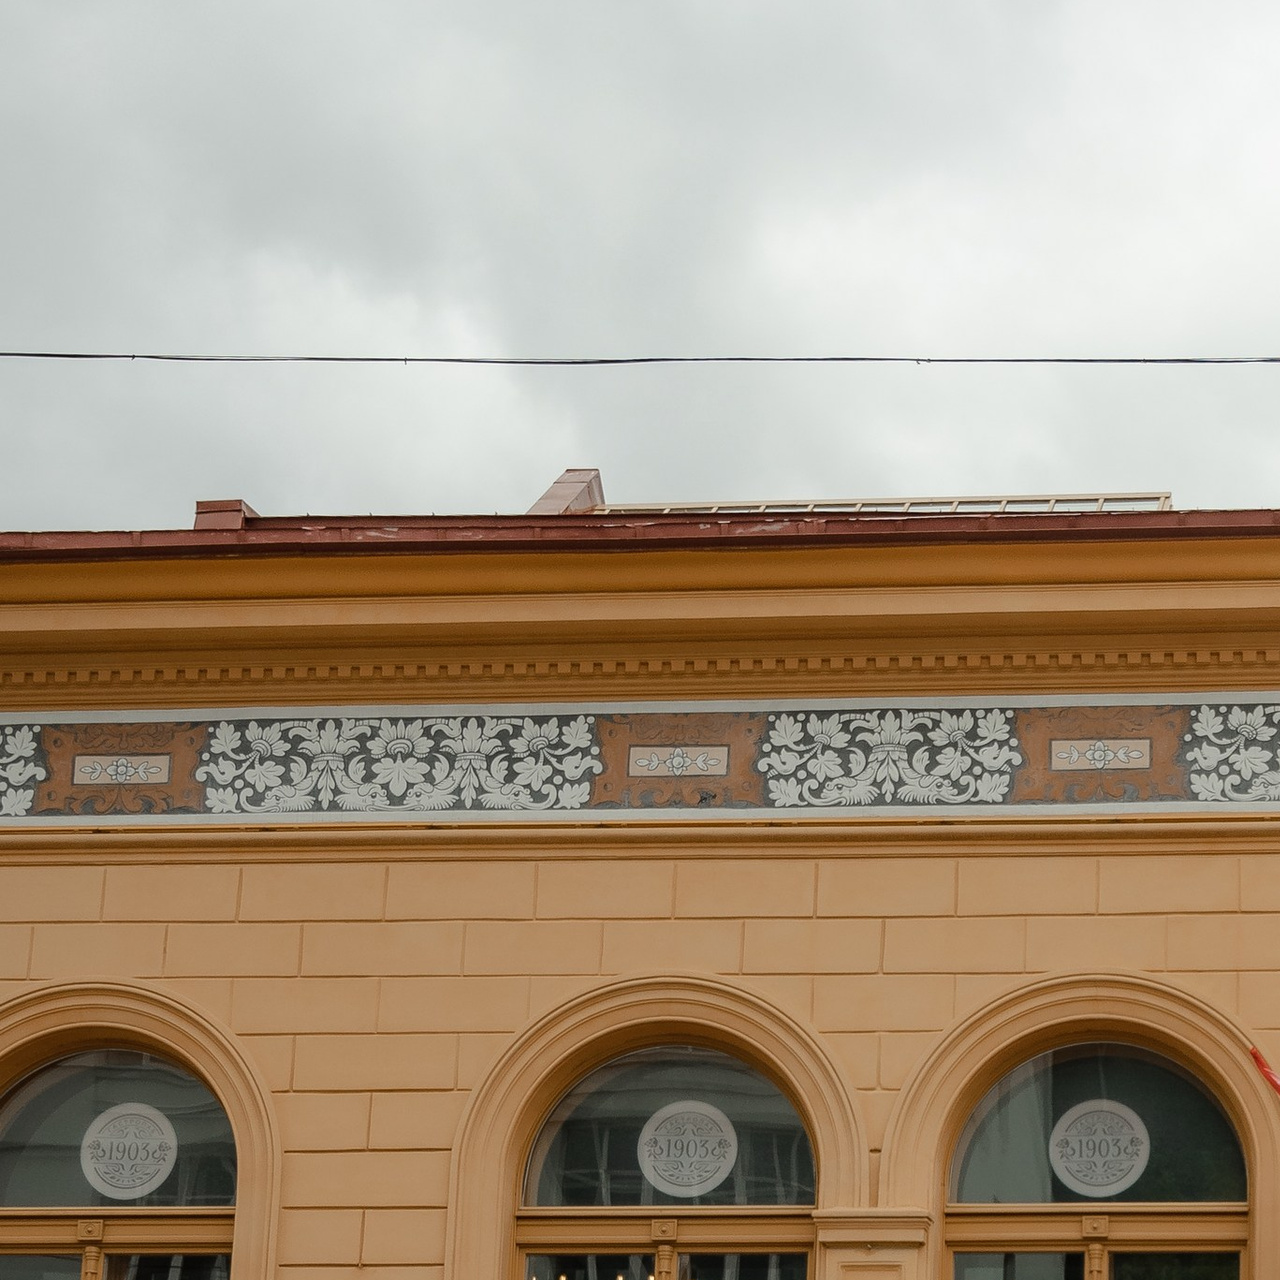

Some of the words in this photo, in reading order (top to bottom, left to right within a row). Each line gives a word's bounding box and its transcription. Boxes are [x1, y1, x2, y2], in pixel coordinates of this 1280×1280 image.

[109, 1141, 150, 1161] 1903
[666, 1139, 709, 1159] 1903
[1078, 1138, 1121, 1158] 1903
